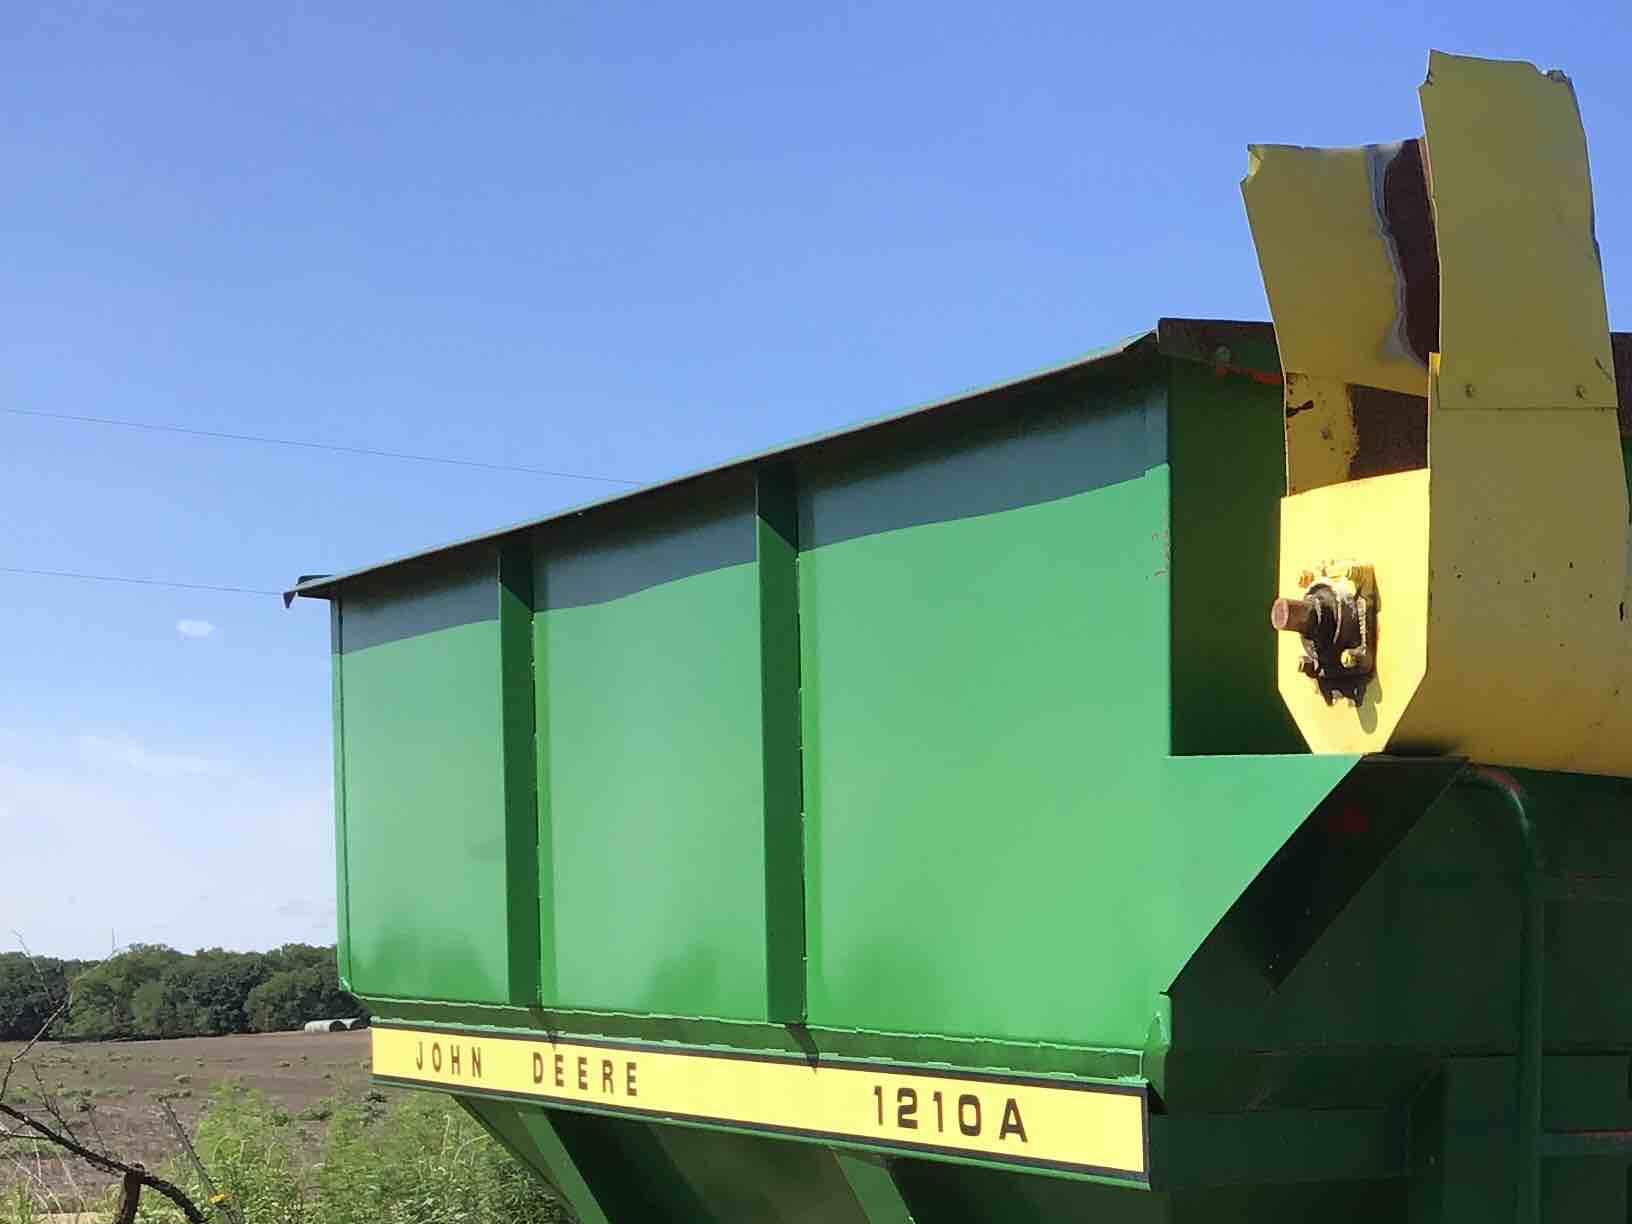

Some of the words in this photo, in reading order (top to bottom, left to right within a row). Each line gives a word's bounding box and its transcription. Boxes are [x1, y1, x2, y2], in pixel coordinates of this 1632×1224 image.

[415, 1040, 482, 1079] JOHN
[532, 1051, 638, 1097] DEERE
[873, 1085, 1029, 1143] 1210A
